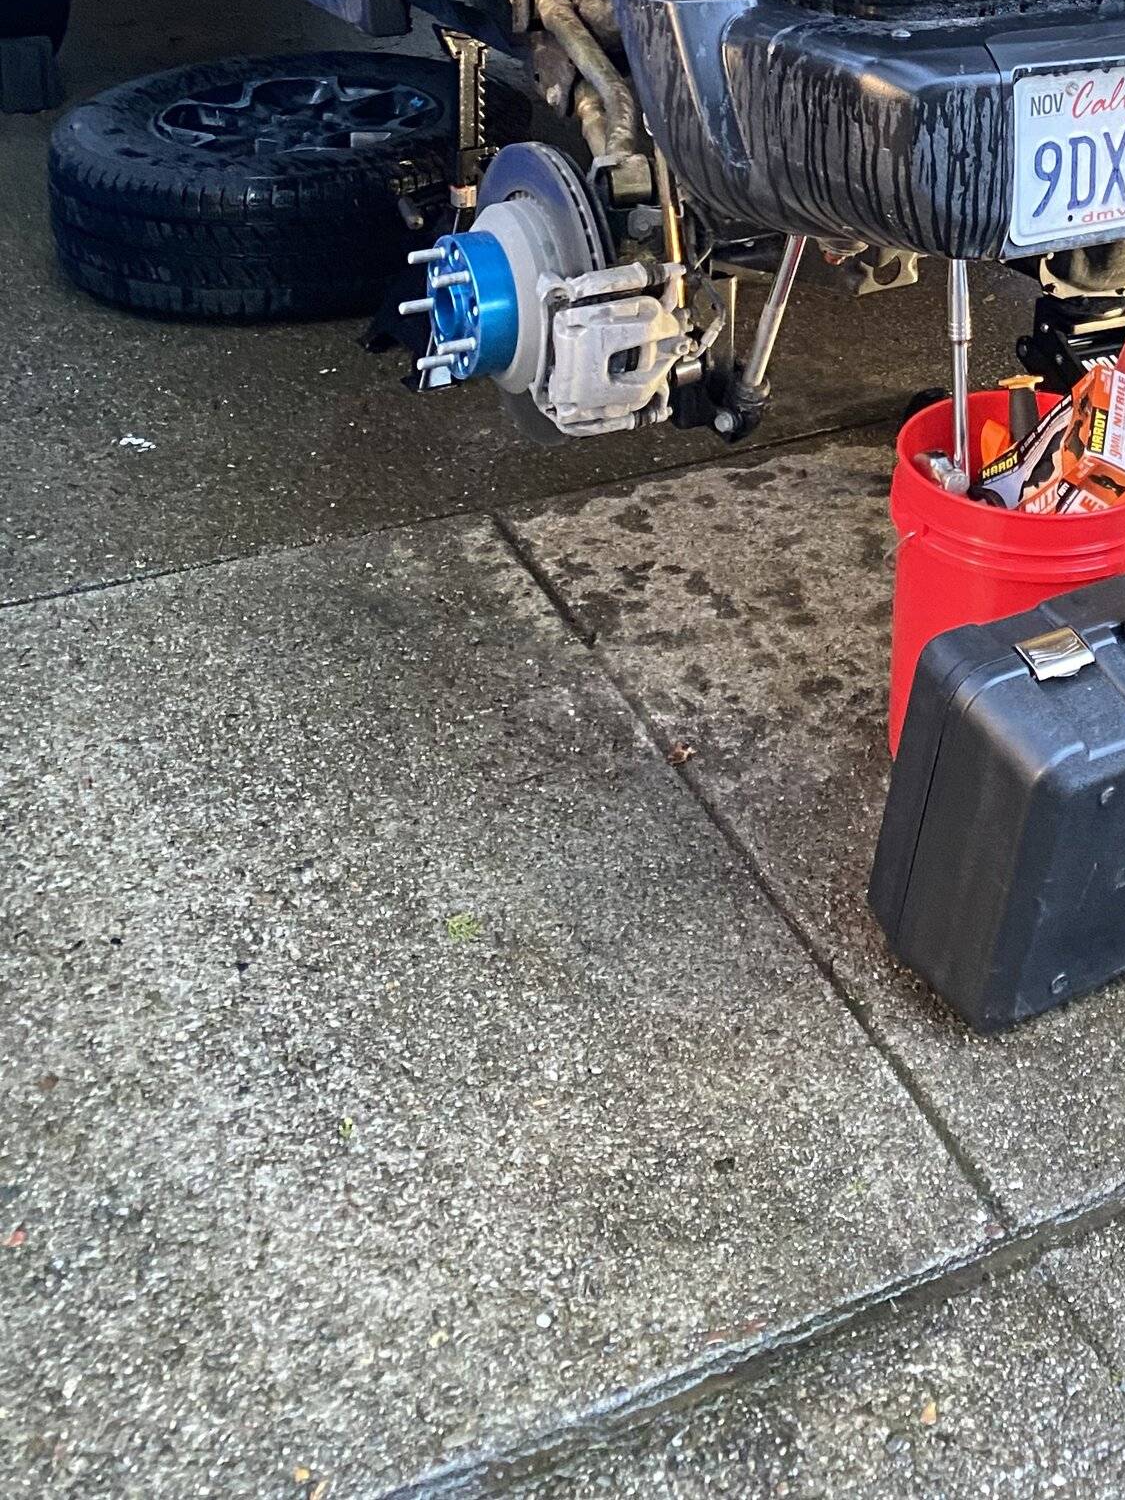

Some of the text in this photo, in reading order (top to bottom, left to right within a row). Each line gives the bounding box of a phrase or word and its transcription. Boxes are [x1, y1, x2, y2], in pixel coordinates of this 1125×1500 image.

[1030, 92, 1064, 117] NOV
[1090, 409, 1107, 453] HARDY
[982, 451, 1019, 479] HARDY
